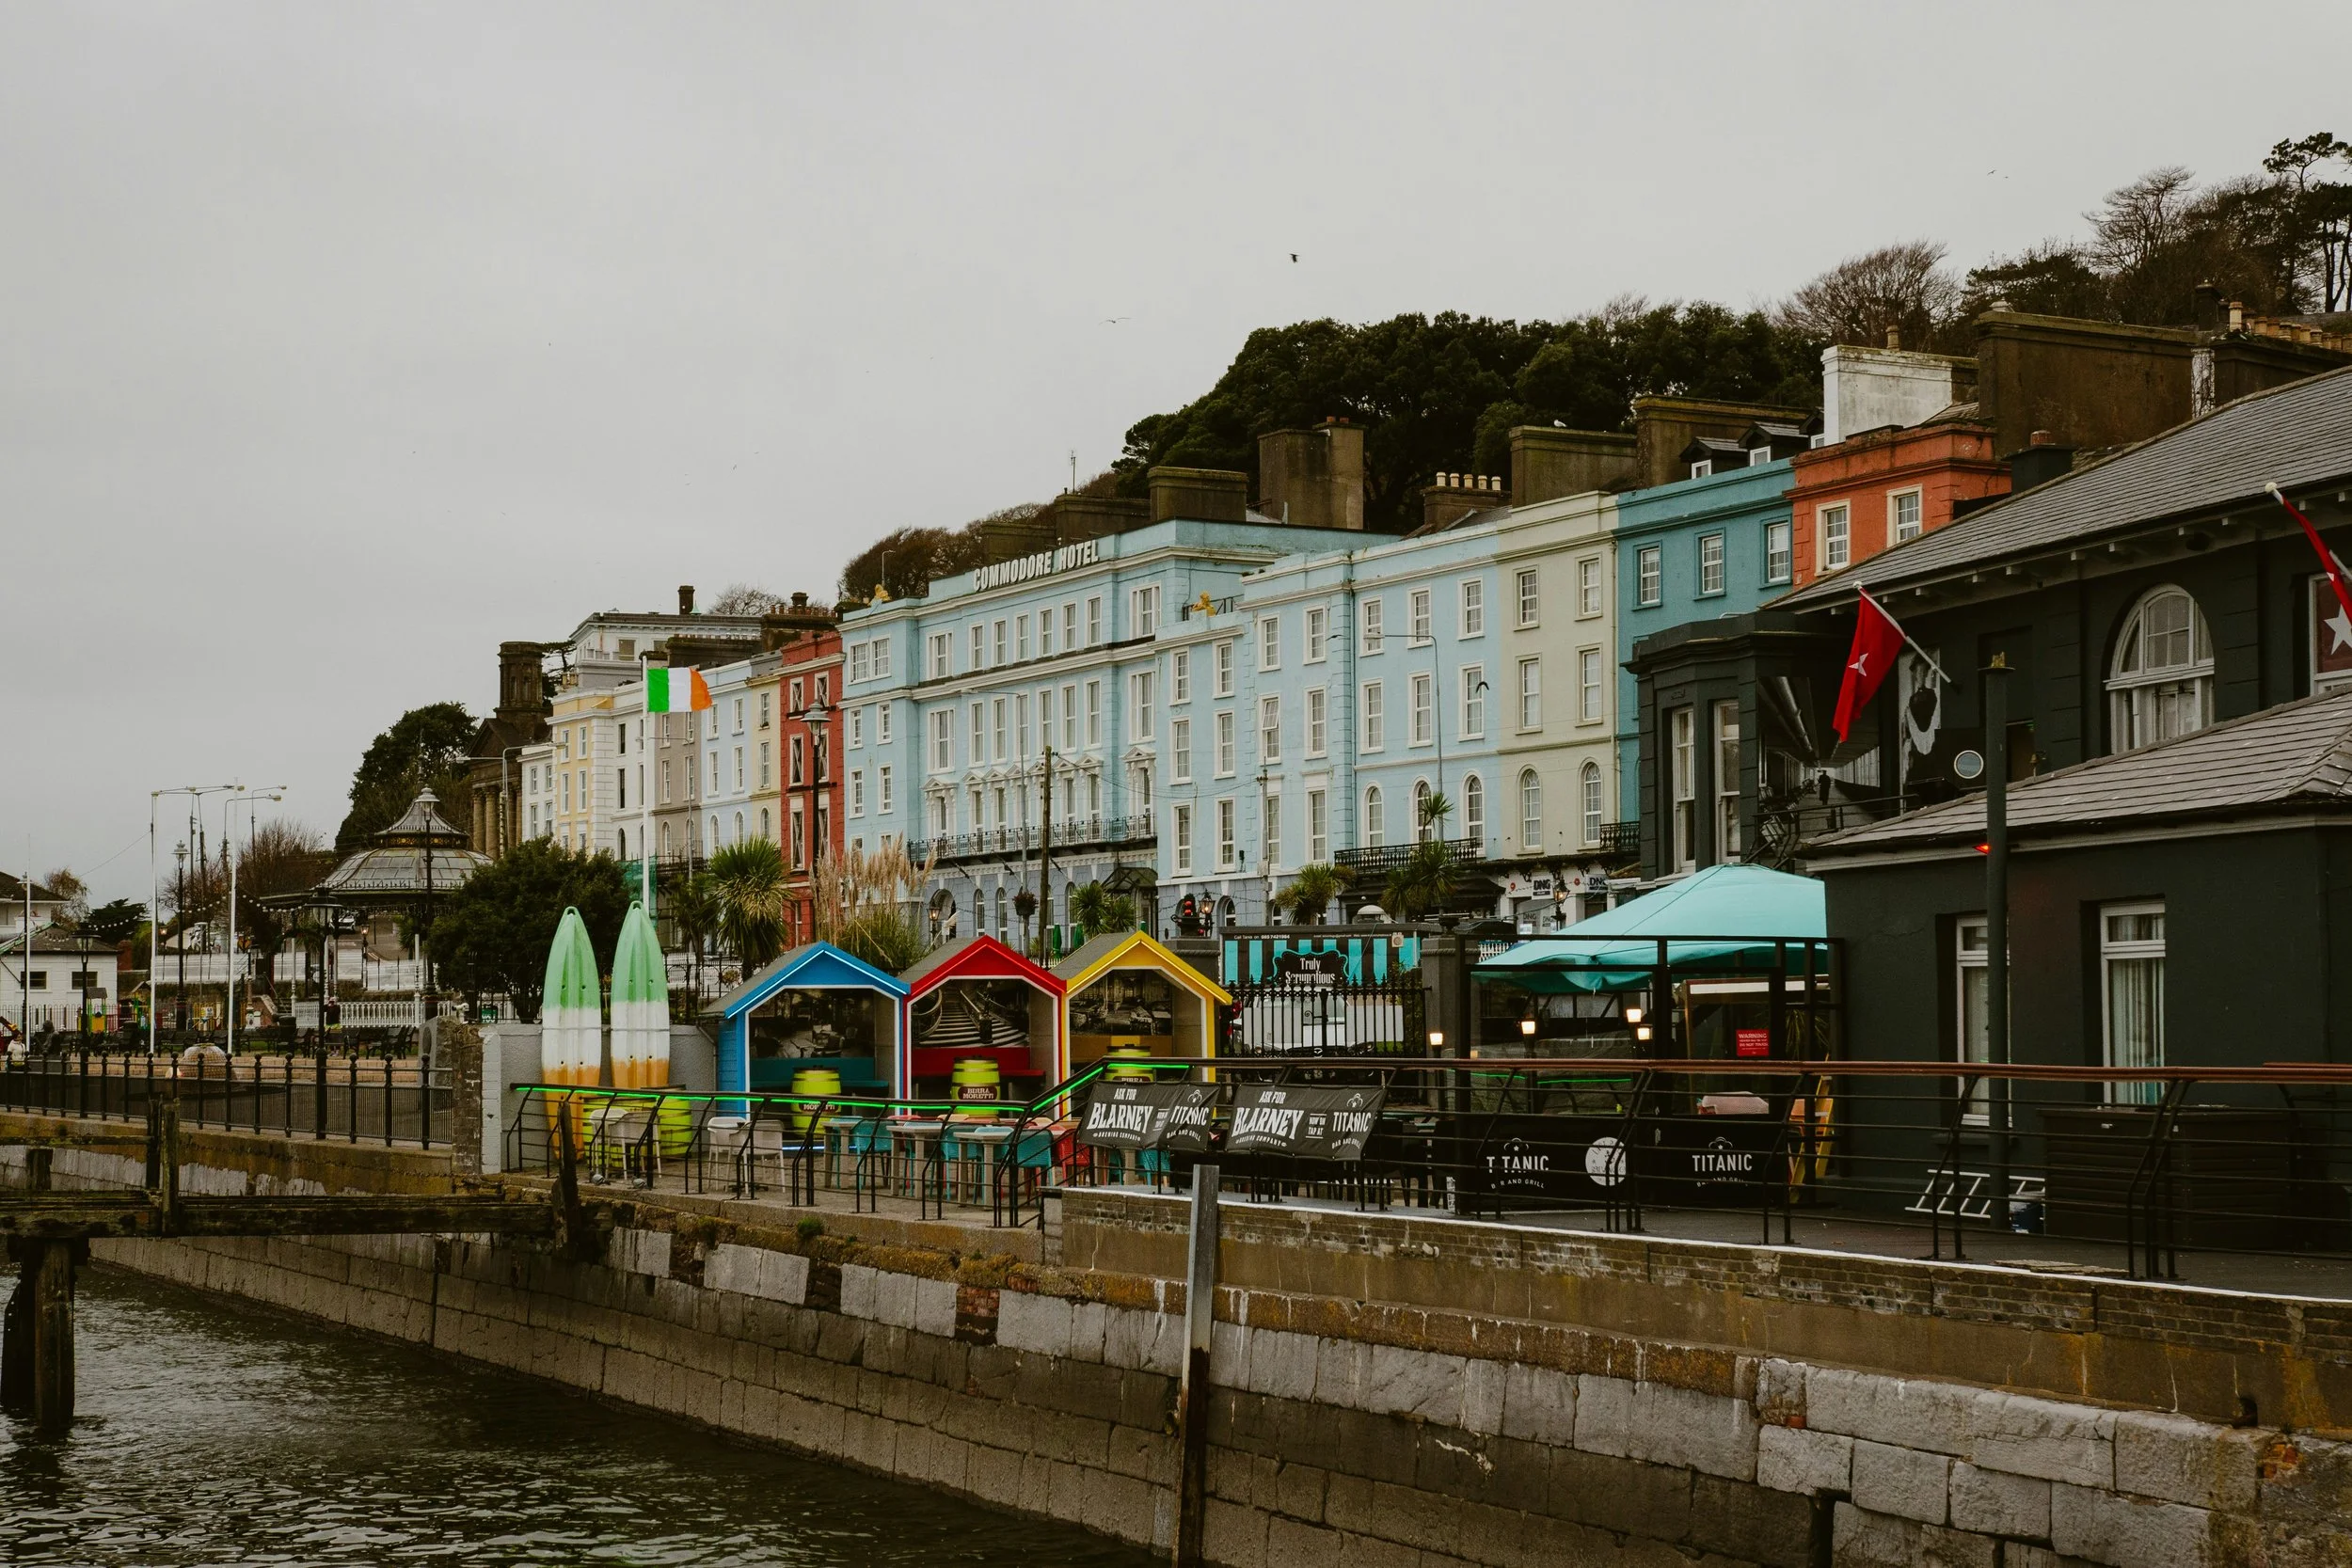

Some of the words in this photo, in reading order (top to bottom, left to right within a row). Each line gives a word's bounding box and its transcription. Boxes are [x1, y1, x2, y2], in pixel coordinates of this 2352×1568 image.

[973, 550, 1053, 592] COMMODORE
[1058, 539, 1099, 571] HOTEL
[1534, 879, 1550, 890] DNG
[1299, 958, 1321, 972] Truly
[1113, 1087, 1126, 1100] ASK
[1125, 1088, 1137, 1101] FOR
[1258, 1091, 1274, 1103] ASK
[1270, 1091, 1287, 1104] FOR
[1087, 1102, 1153, 1133] BLARNEY
[1169, 1105, 1210, 1127] TITANIC
[1332, 1112, 1372, 1132] TITANIC
[1232, 1107, 1305, 1140] BLARNEY
[1167, 1130, 1177, 1139] BAR
[1188, 1130, 1201, 1142] GRILL
[1308, 1127, 1317, 1135] TAP
[1316, 1127, 1324, 1135] AT
[1256, 1134, 1281, 1147] COMPANY
[1331, 1139, 1342, 1149] BAR
[1486, 1155, 1549, 1174] TTANIC
[1692, 1154, 1753, 1172] TITANIC
[1490, 1180, 1505, 1189] BR
[1524, 1179, 1545, 1189] GRILL
